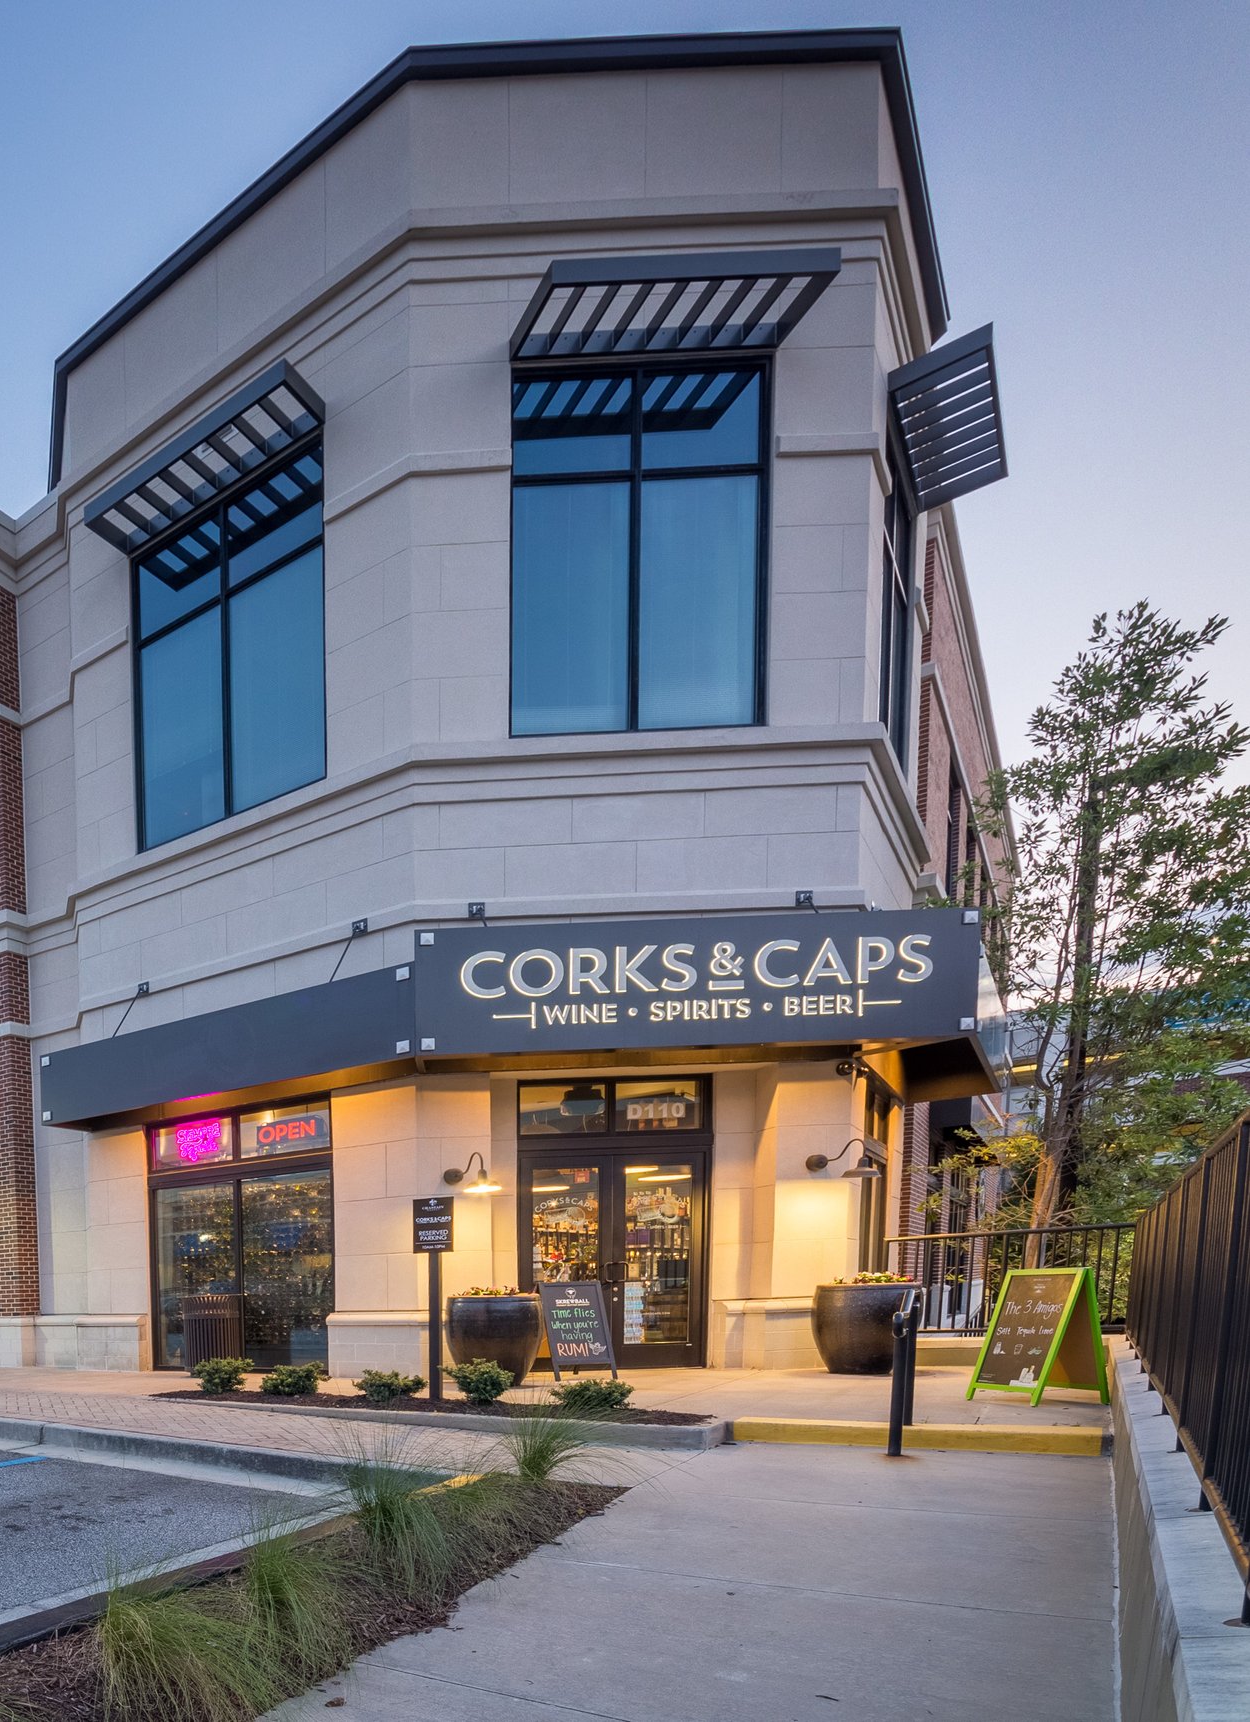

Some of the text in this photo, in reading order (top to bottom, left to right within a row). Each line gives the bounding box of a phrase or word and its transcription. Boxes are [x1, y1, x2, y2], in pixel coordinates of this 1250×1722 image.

[460, 943, 698, 999] CORKS
[753, 934, 934, 988] CAPS
[542, 994, 854, 1026] WINE SPIRITS BEER
[627, 1102, 685, 1119] D110
[258, 1119, 316, 1144] OPEN
[1005, 1299, 1064, 1320] The 3 Amigos
[560, 1330, 594, 1343] having
